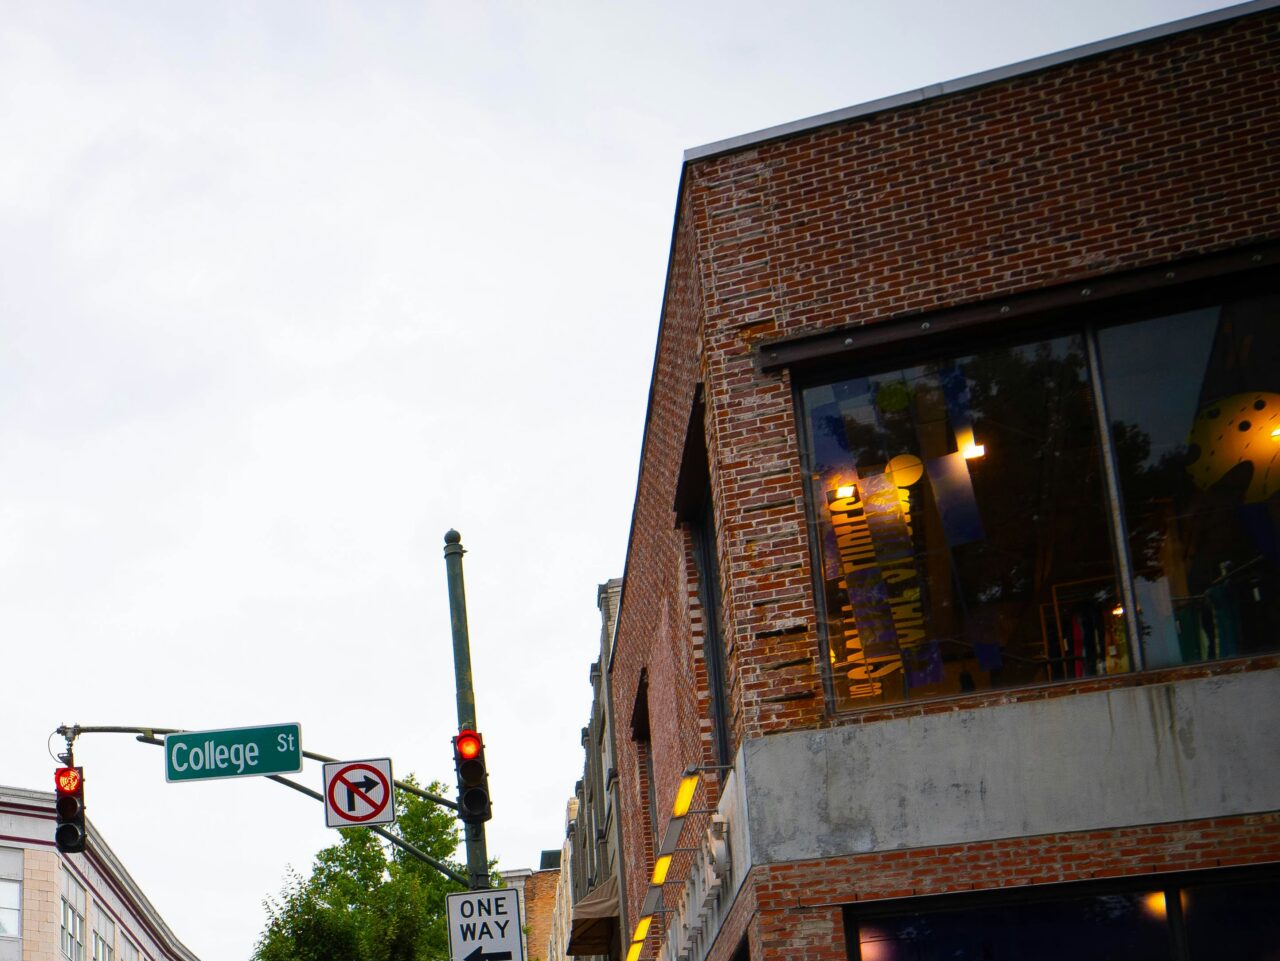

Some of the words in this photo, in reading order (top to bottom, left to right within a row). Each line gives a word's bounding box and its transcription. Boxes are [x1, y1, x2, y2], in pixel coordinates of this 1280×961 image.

[172, 740, 259, 773] College
[276, 733, 295, 752] St
[460, 897, 508, 918] ONE
[459, 920, 510, 942] WAY
